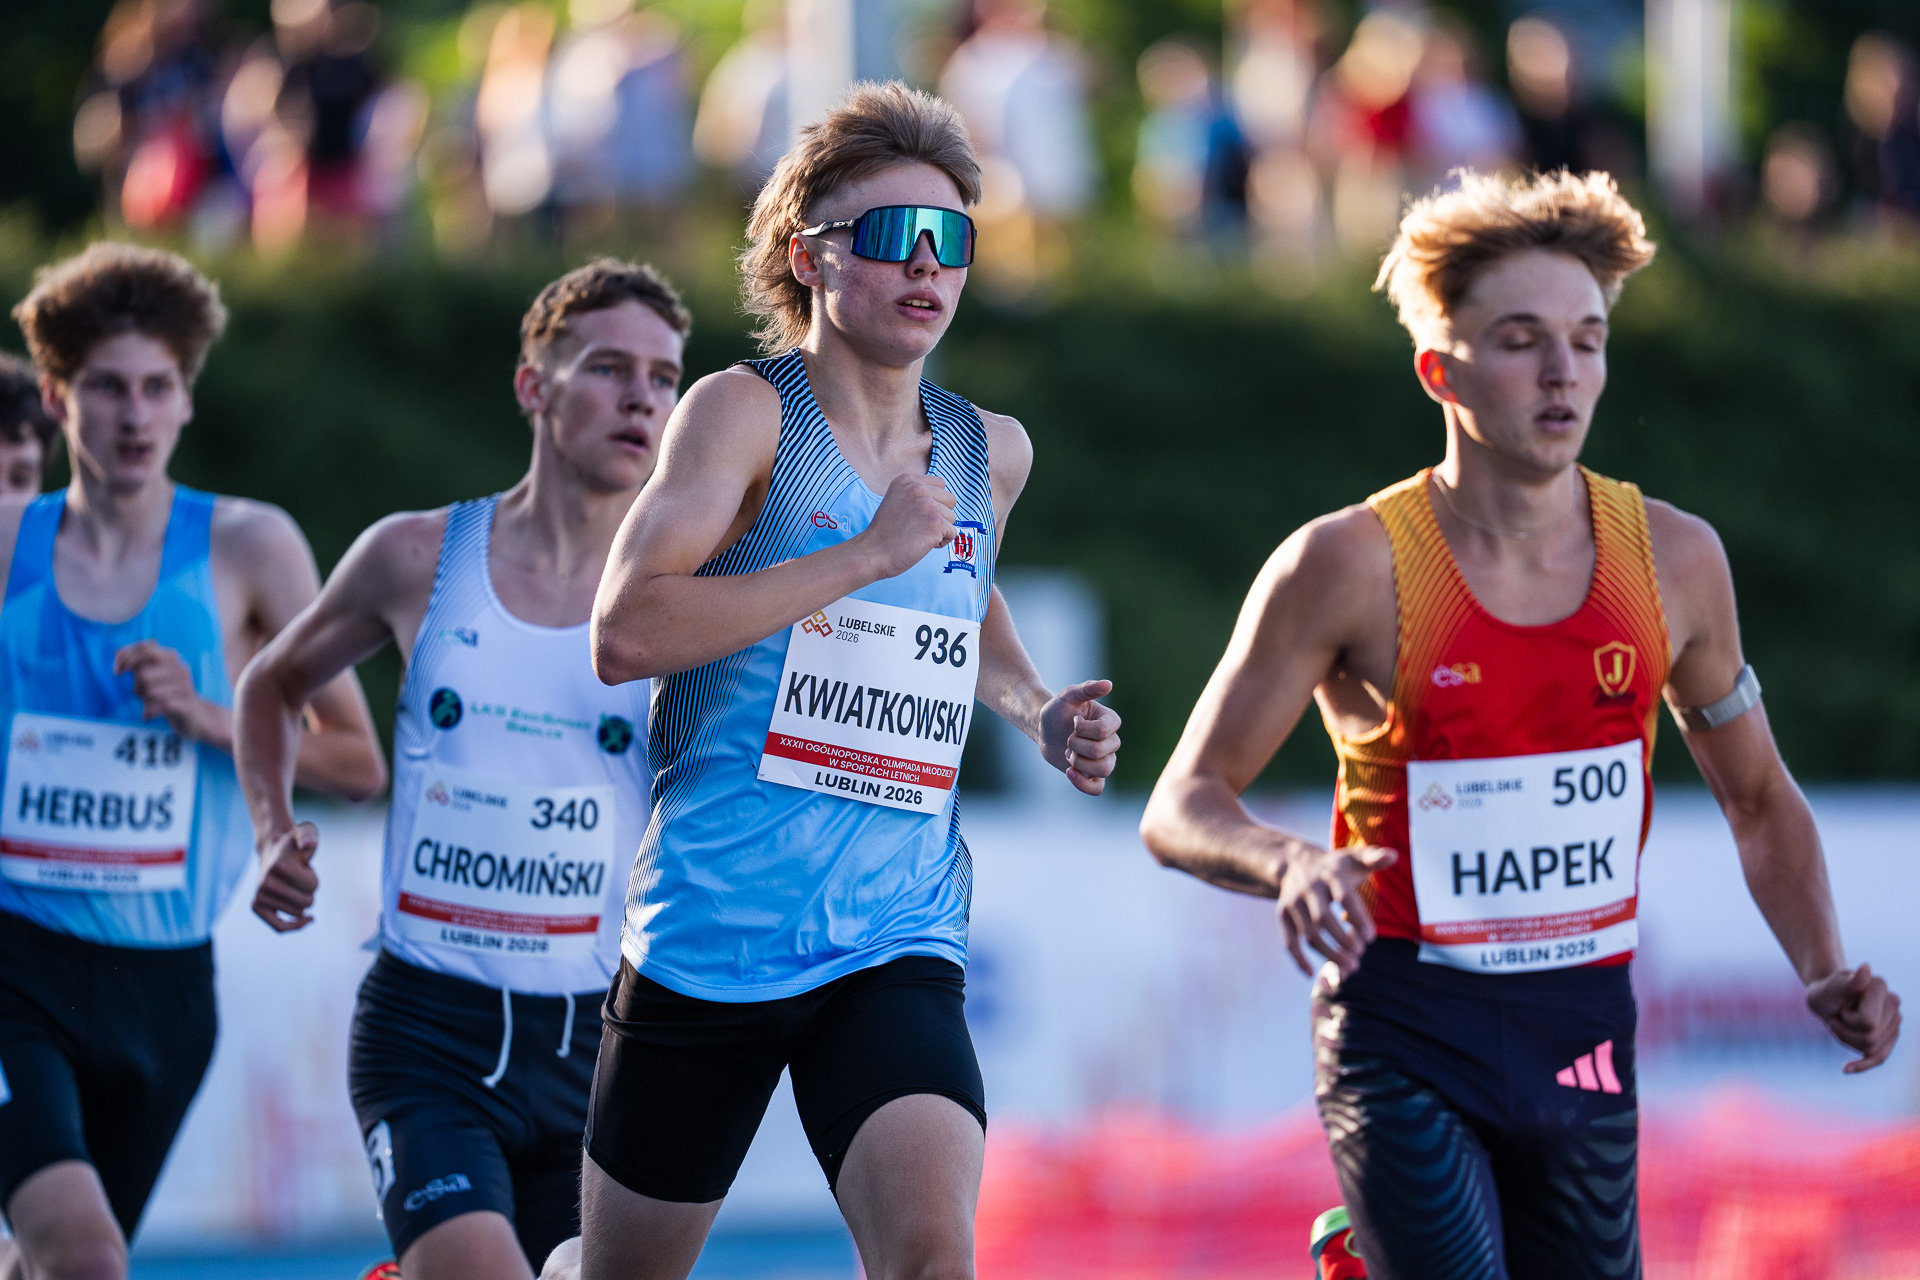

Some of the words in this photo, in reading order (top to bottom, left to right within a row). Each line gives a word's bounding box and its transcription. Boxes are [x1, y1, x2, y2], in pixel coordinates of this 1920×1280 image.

[835, 629, 860, 643] 2026
[838, 616, 896, 637] LUBELSKIE
[914, 624, 968, 668] 936
[1605, 652, 1623, 685] J
[783, 671, 967, 745] KWIATKOWSKI
[114, 733, 182, 767] 418
[779, 737, 805, 750] XXXII
[805, 742, 880, 766] OGÓLNOPOLSKA
[881, 758, 921, 773] OLIMPIADA
[829, 758, 839, 767] W
[840, 760, 890, 778] SPORTACH
[890, 770, 920, 783] LETNICH
[1552, 760, 1627, 806] 500
[814, 771, 882, 798] LUBLIN
[883, 785, 923, 805] 2026
[19, 782, 174, 830] HERBUŚ
[530, 797, 599, 831] 340
[414, 837, 605, 896] CHROMIŃSKI
[1453, 837, 1615, 895] HAPEK
[441, 927, 502, 949] LUBLIN
[1481, 947, 1549, 967] LUBLIN
[1555, 938, 1597, 960] 2026
